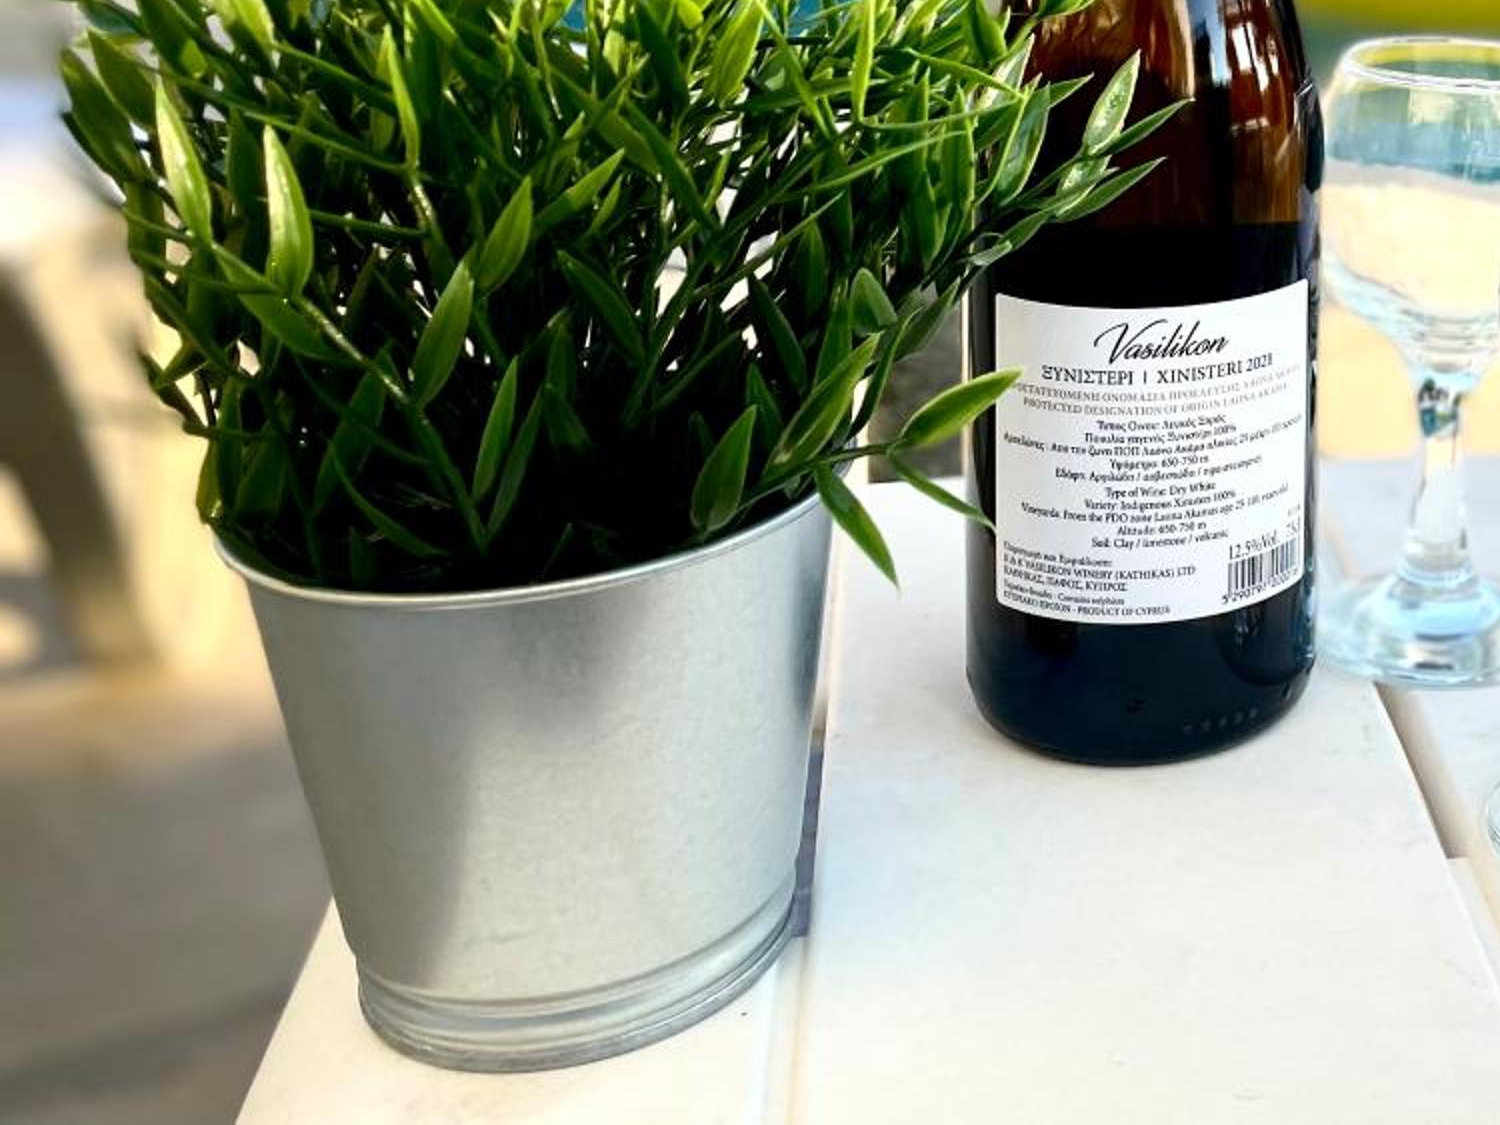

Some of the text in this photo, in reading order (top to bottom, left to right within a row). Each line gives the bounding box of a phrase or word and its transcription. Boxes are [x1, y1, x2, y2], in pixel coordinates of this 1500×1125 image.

[1093, 319, 1229, 364] Vasilikon
[1041, 364, 1134, 385] ΞΥΝΙΣΤΕΡΙ
[1157, 360, 1243, 384] XINISTERI
[1245, 352, 1273, 372] 2021
[1083, 404, 1162, 416] DESIGNATION
[1113, 537, 1135, 551] Clay
